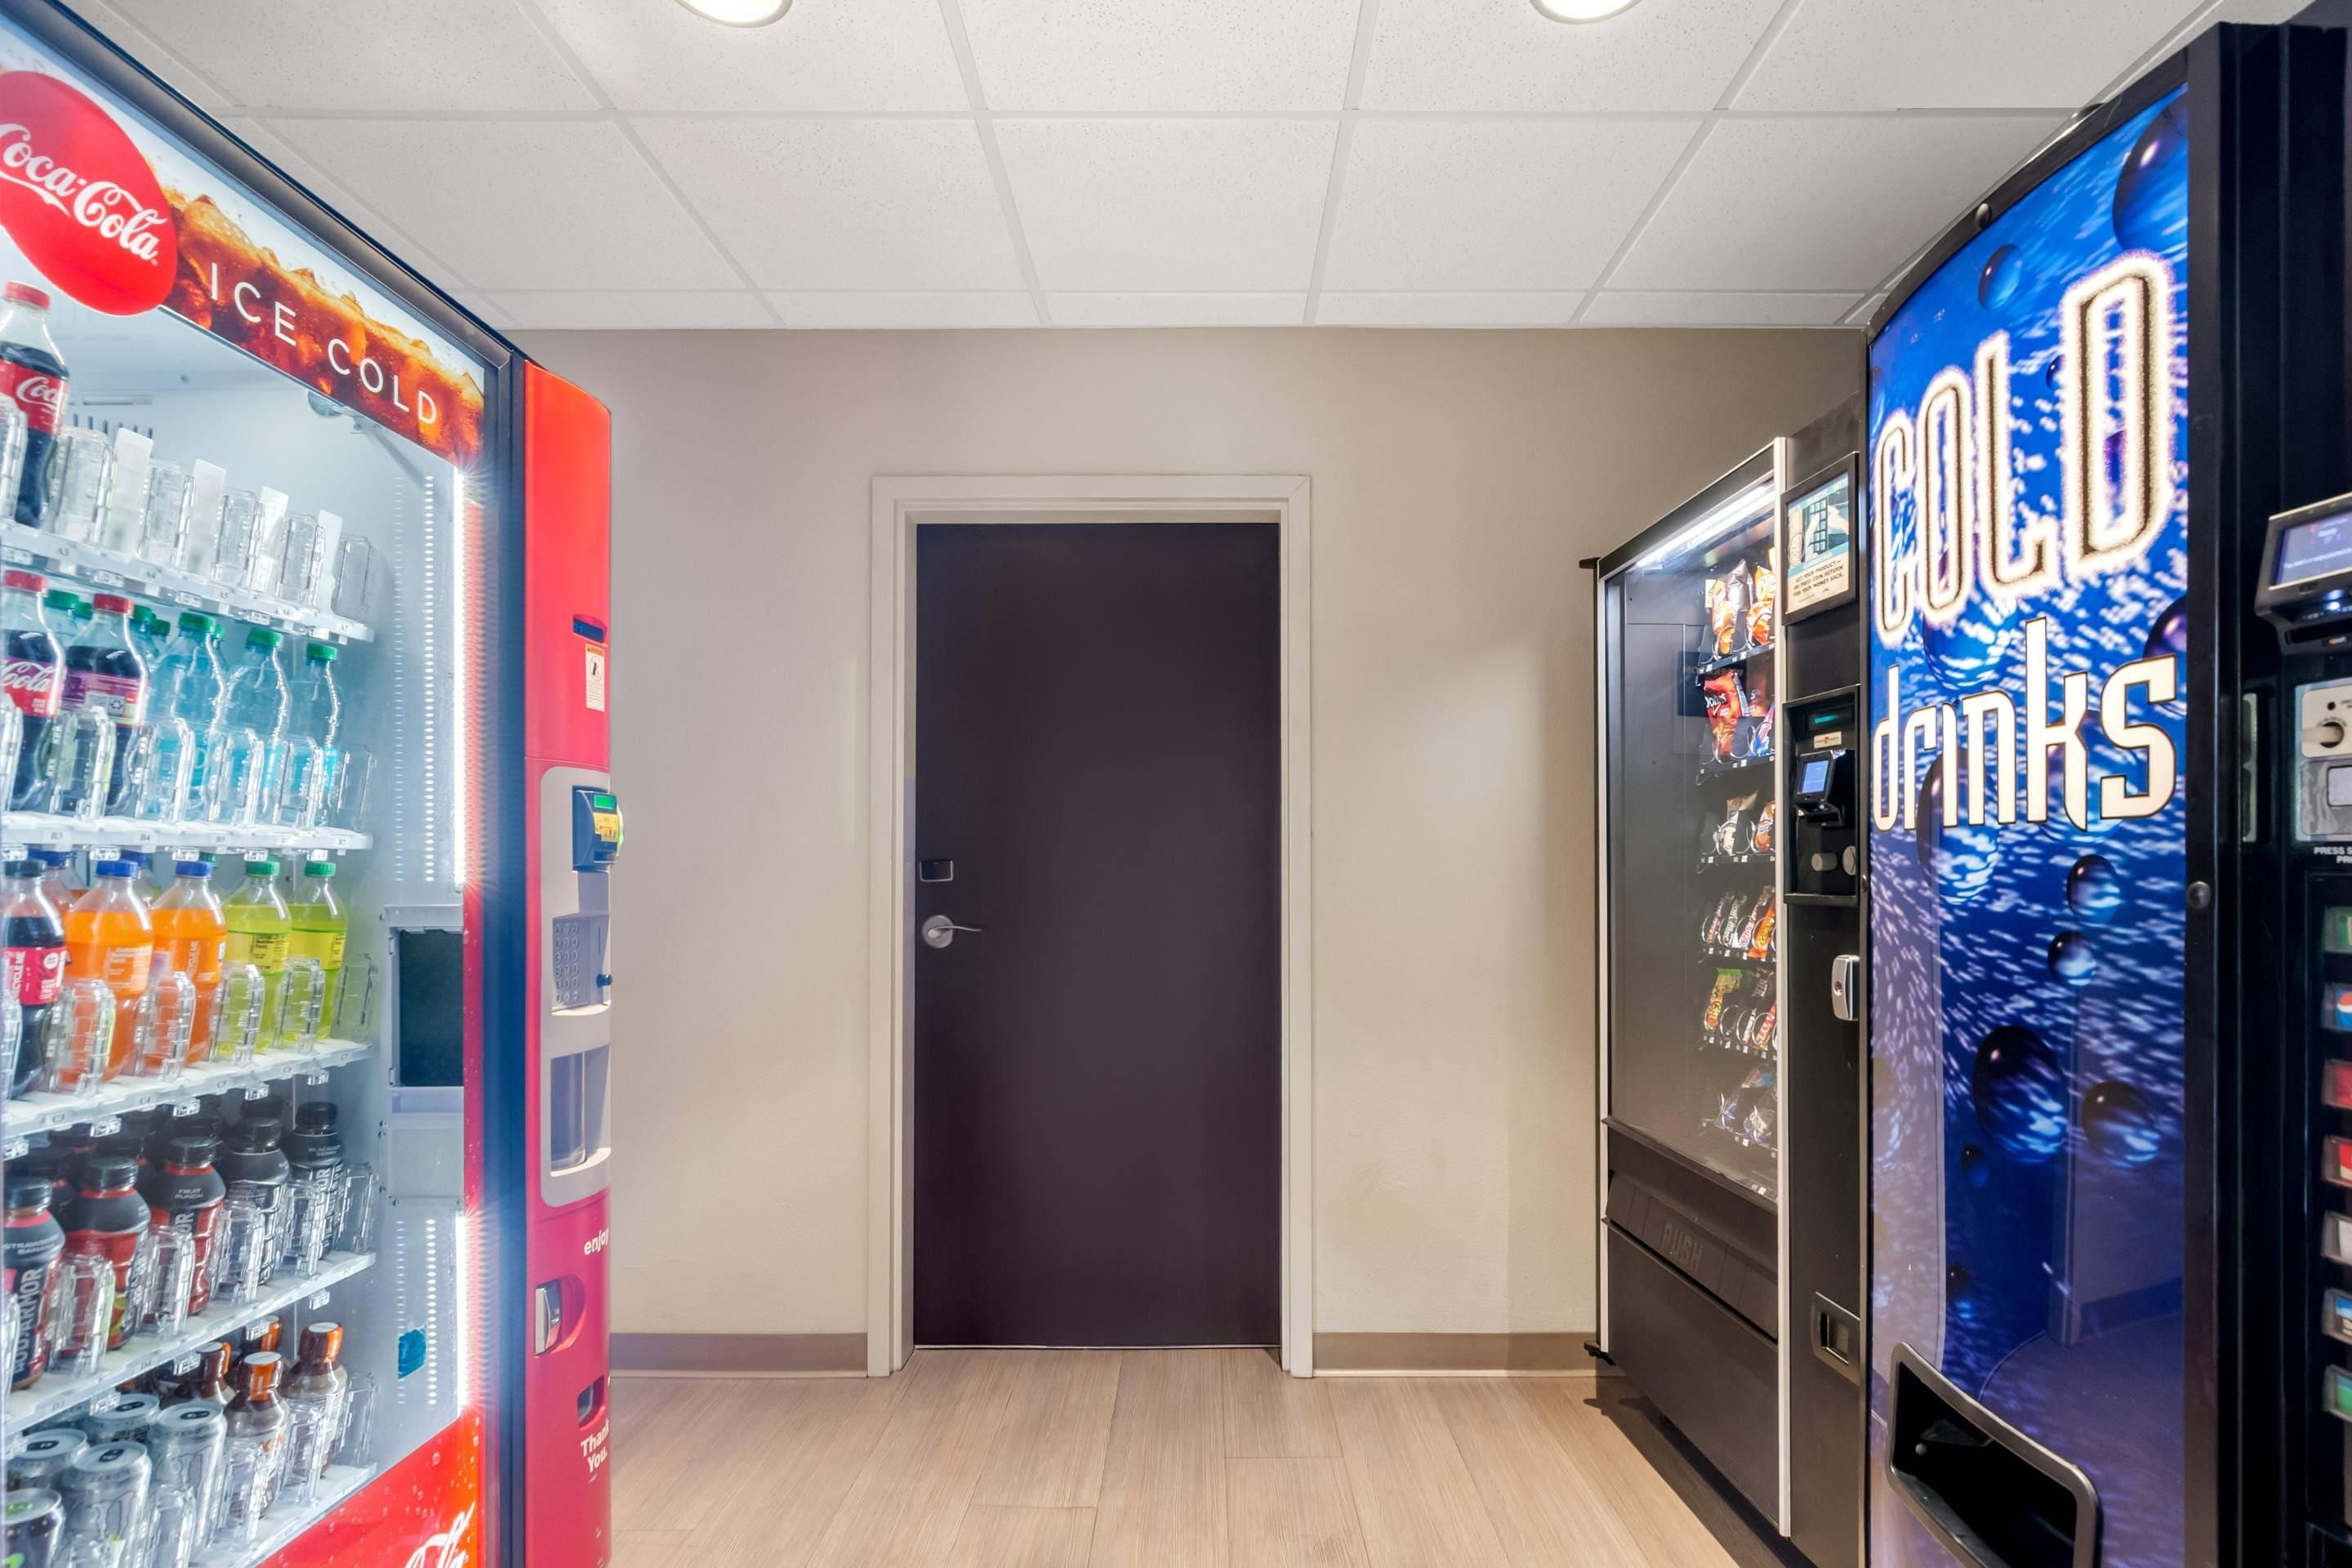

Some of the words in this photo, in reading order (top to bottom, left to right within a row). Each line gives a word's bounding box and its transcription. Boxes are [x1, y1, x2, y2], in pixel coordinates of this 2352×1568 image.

[211, 262, 297, 346] ICE
[327, 337, 438, 425] COLD
[1872, 252, 2176, 645] COLD
[1872, 617, 2178, 832] drinks
[2314, 847, 2345, 855] PRESS
[584, 1227, 609, 1255] enjoy
[1661, 1223, 1704, 1275] PUSH
